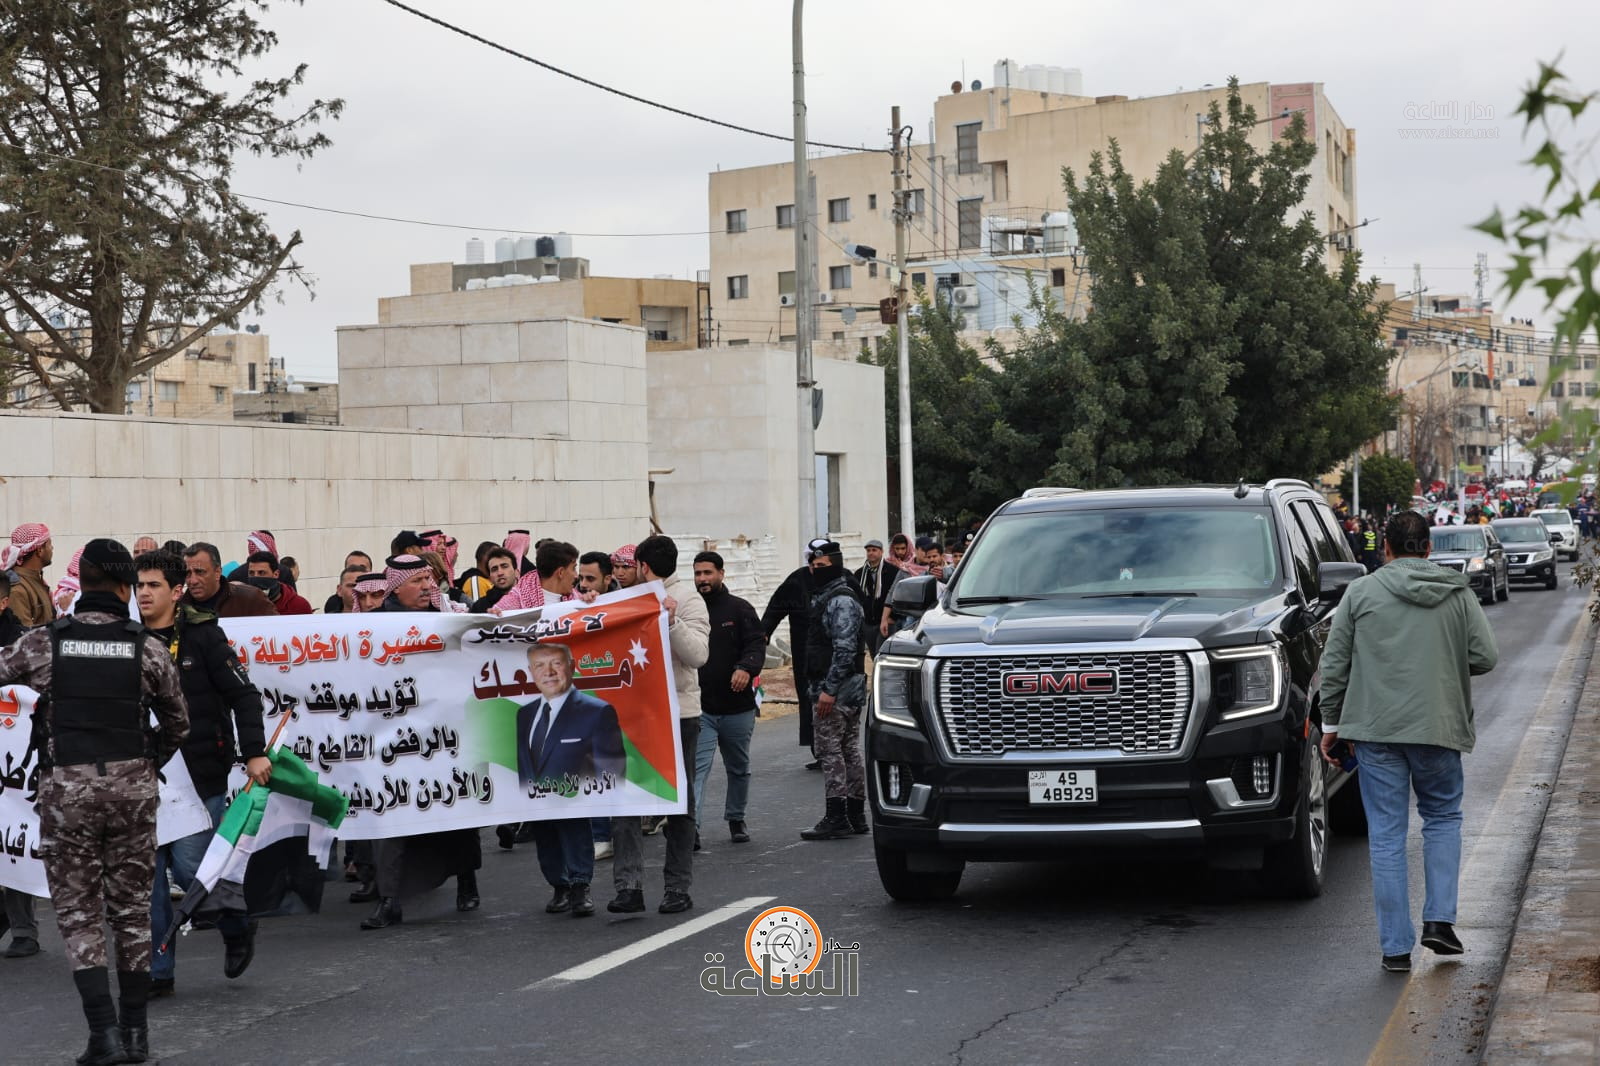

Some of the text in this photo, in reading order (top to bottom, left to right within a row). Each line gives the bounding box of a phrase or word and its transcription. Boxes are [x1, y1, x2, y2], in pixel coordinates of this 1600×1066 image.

[358, 626, 445, 664] عشيرة
[467, 612, 607, 644] لا للتهجير
[62, 641, 133, 656] GENDARMERIE
[252, 633, 349, 672] الخلايلة
[578, 651, 614, 672] شعبك
[305, 682, 360, 720] موقف
[365, 676, 418, 718] تؤيد
[1006, 672, 1113, 694] GMC
[318, 734, 374, 772] القاطع
[381, 722, 459, 766] بالرفض
[416, 767, 493, 811] والأردن
[1043, 787, 1094, 801] 48929
[1058, 771, 1077, 786] 49
